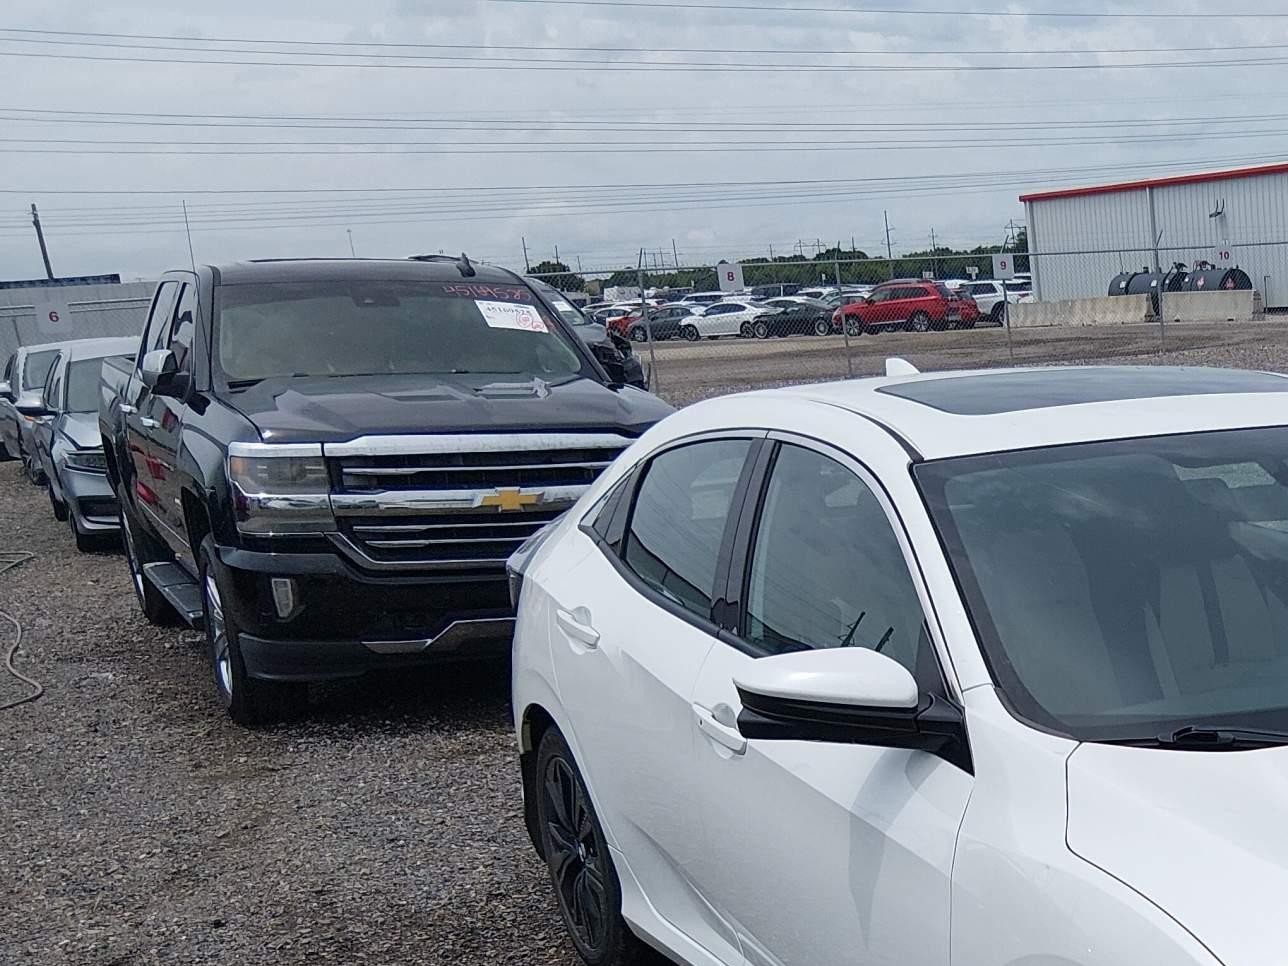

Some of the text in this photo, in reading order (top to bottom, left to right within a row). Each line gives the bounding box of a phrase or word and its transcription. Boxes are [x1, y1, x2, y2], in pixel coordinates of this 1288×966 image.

[1219, 251, 1230, 260] 10
[1000, 260, 1007, 270] 9
[727, 271, 735, 281] 8
[49, 311, 60, 322] 6
